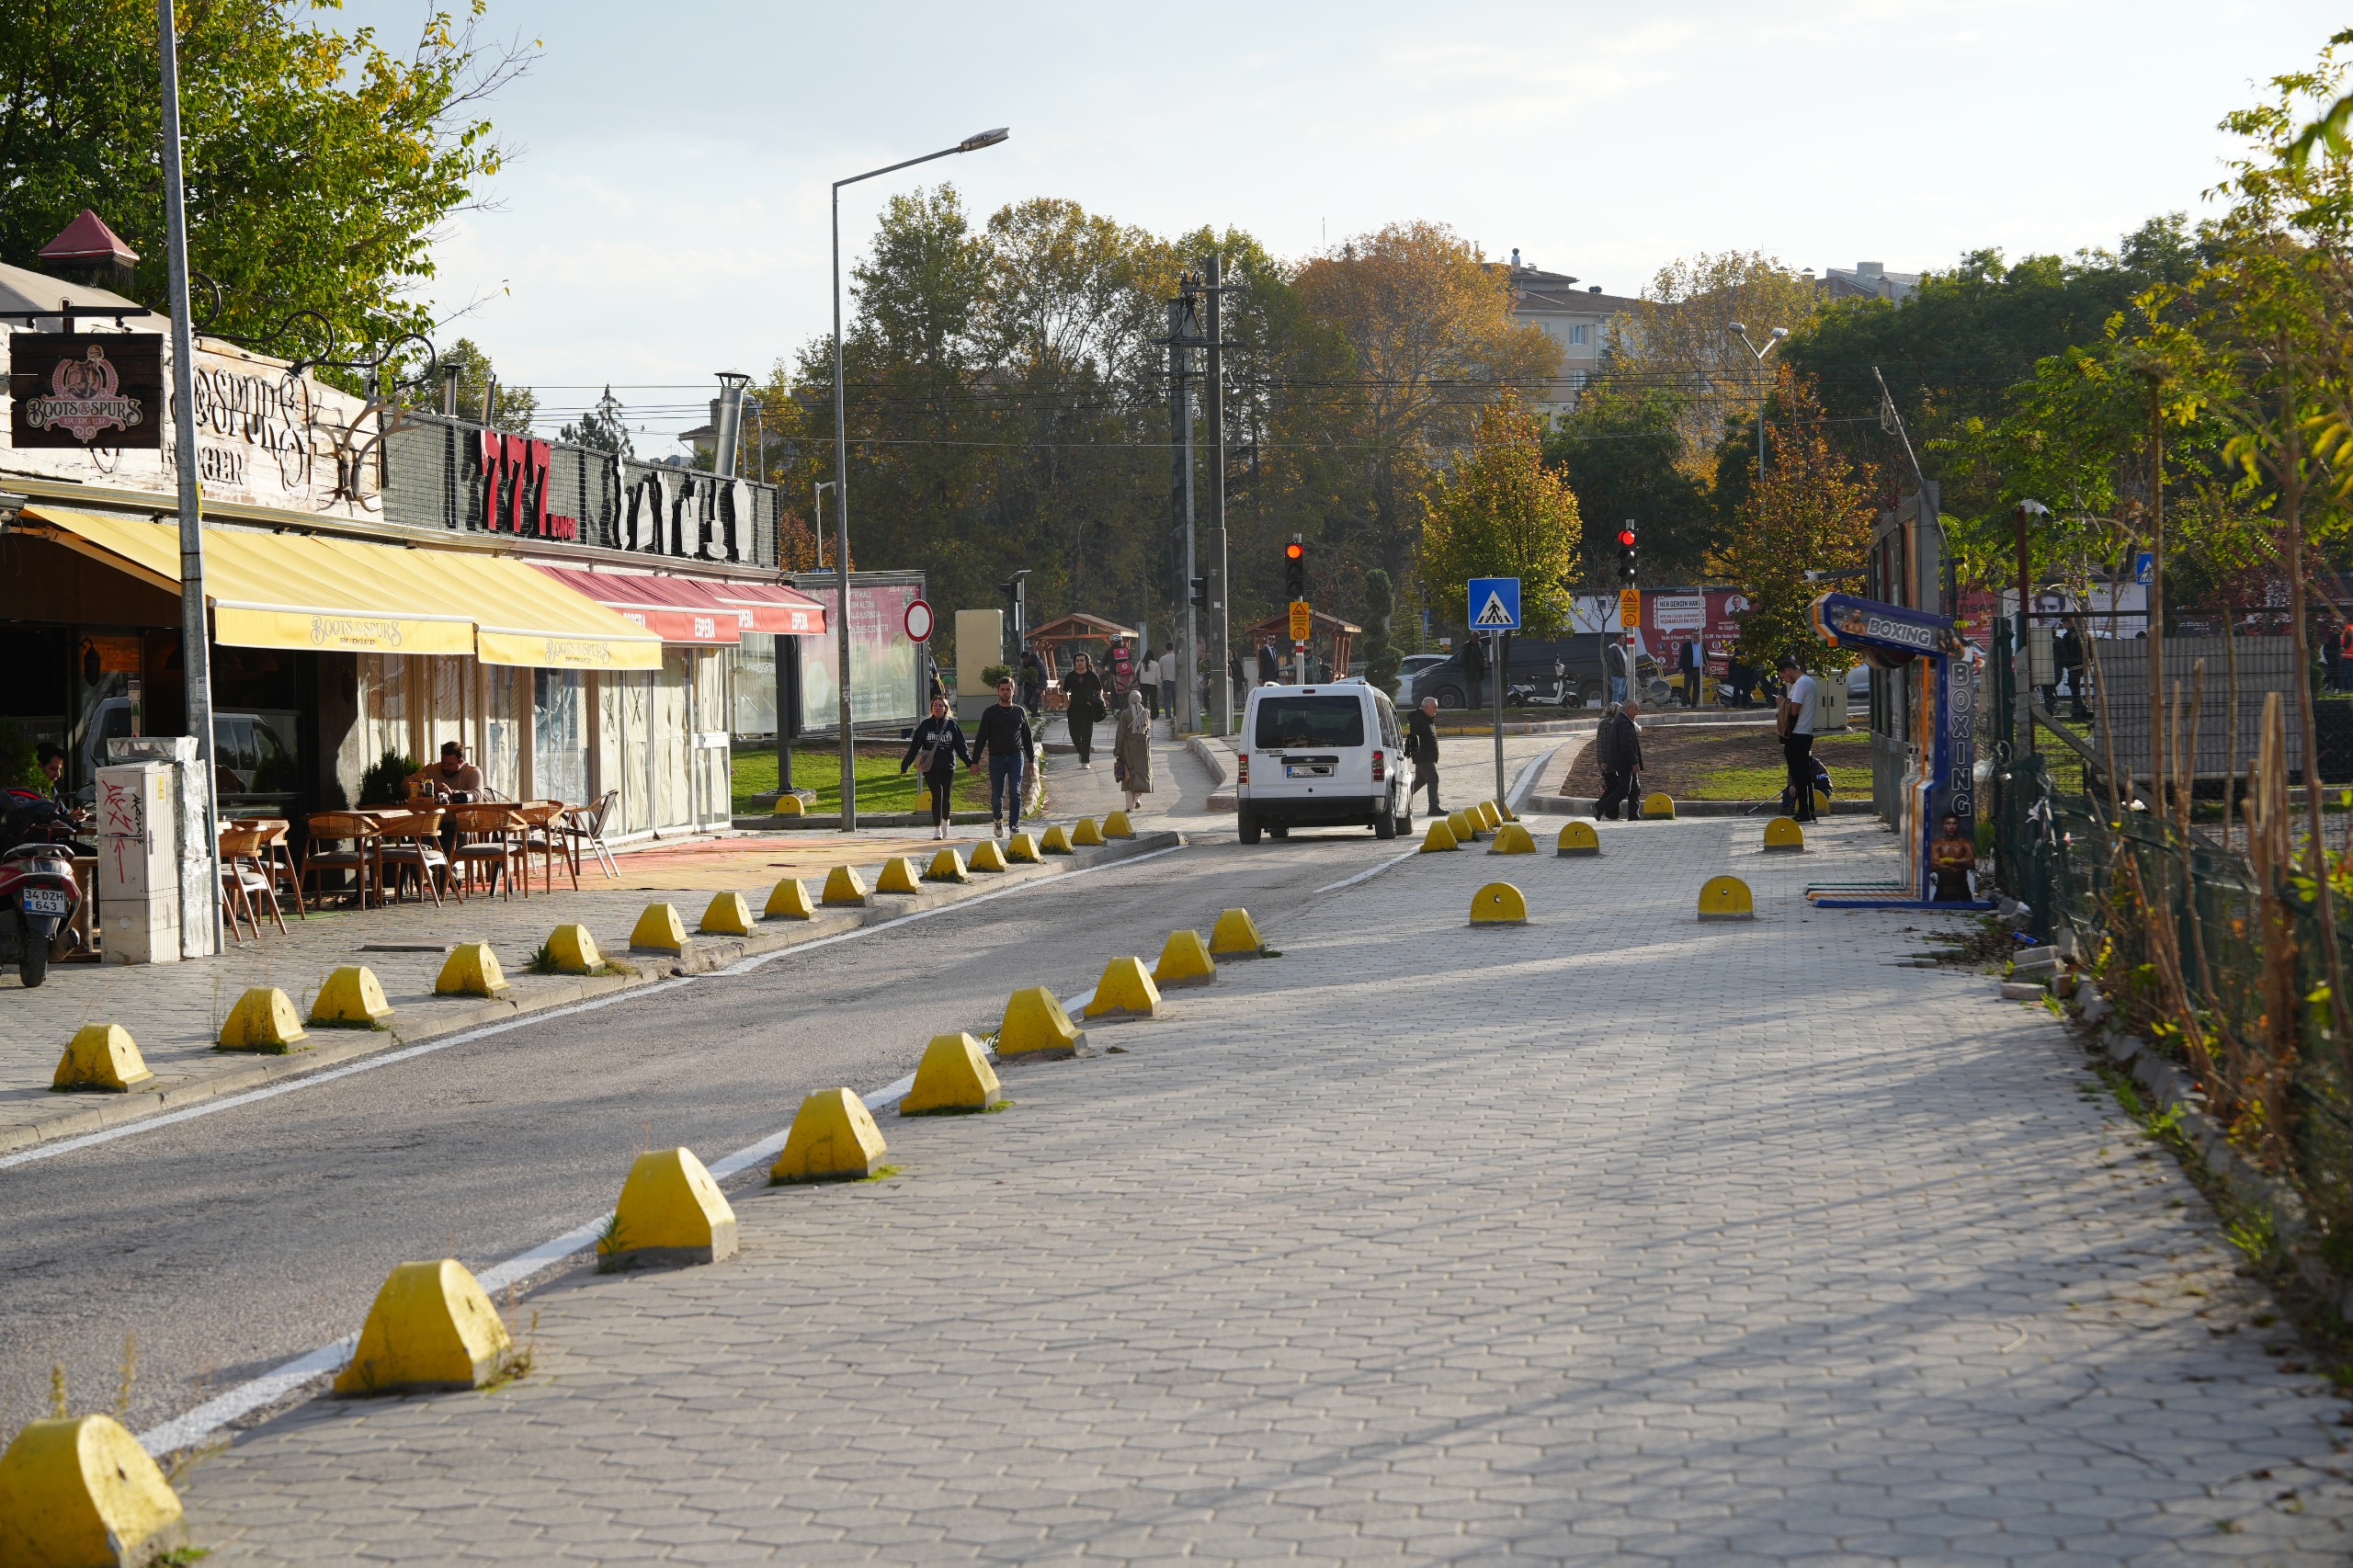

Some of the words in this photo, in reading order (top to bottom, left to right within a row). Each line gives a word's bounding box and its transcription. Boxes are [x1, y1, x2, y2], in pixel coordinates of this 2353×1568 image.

[27, 399, 78, 426] BOOTS
[78, 402, 90, 415] &
[90, 400, 142, 426] SPURS
[694, 617, 715, 639] ESPERA
[739, 608, 755, 628] SPERA
[310, 616, 352, 645] BOOTS
[363, 620, 402, 647] SPURS
[340, 637, 376, 646] BURGER
[1868, 618, 1931, 646] BOXING
[544, 639, 574, 665] BOOTS
[583, 642, 611, 665] SPURS
[1949, 663, 1972, 817] BOXING
[26, 890, 40, 900] 34
[42, 892, 63, 901] DZH
[36, 901, 57, 911] 643
